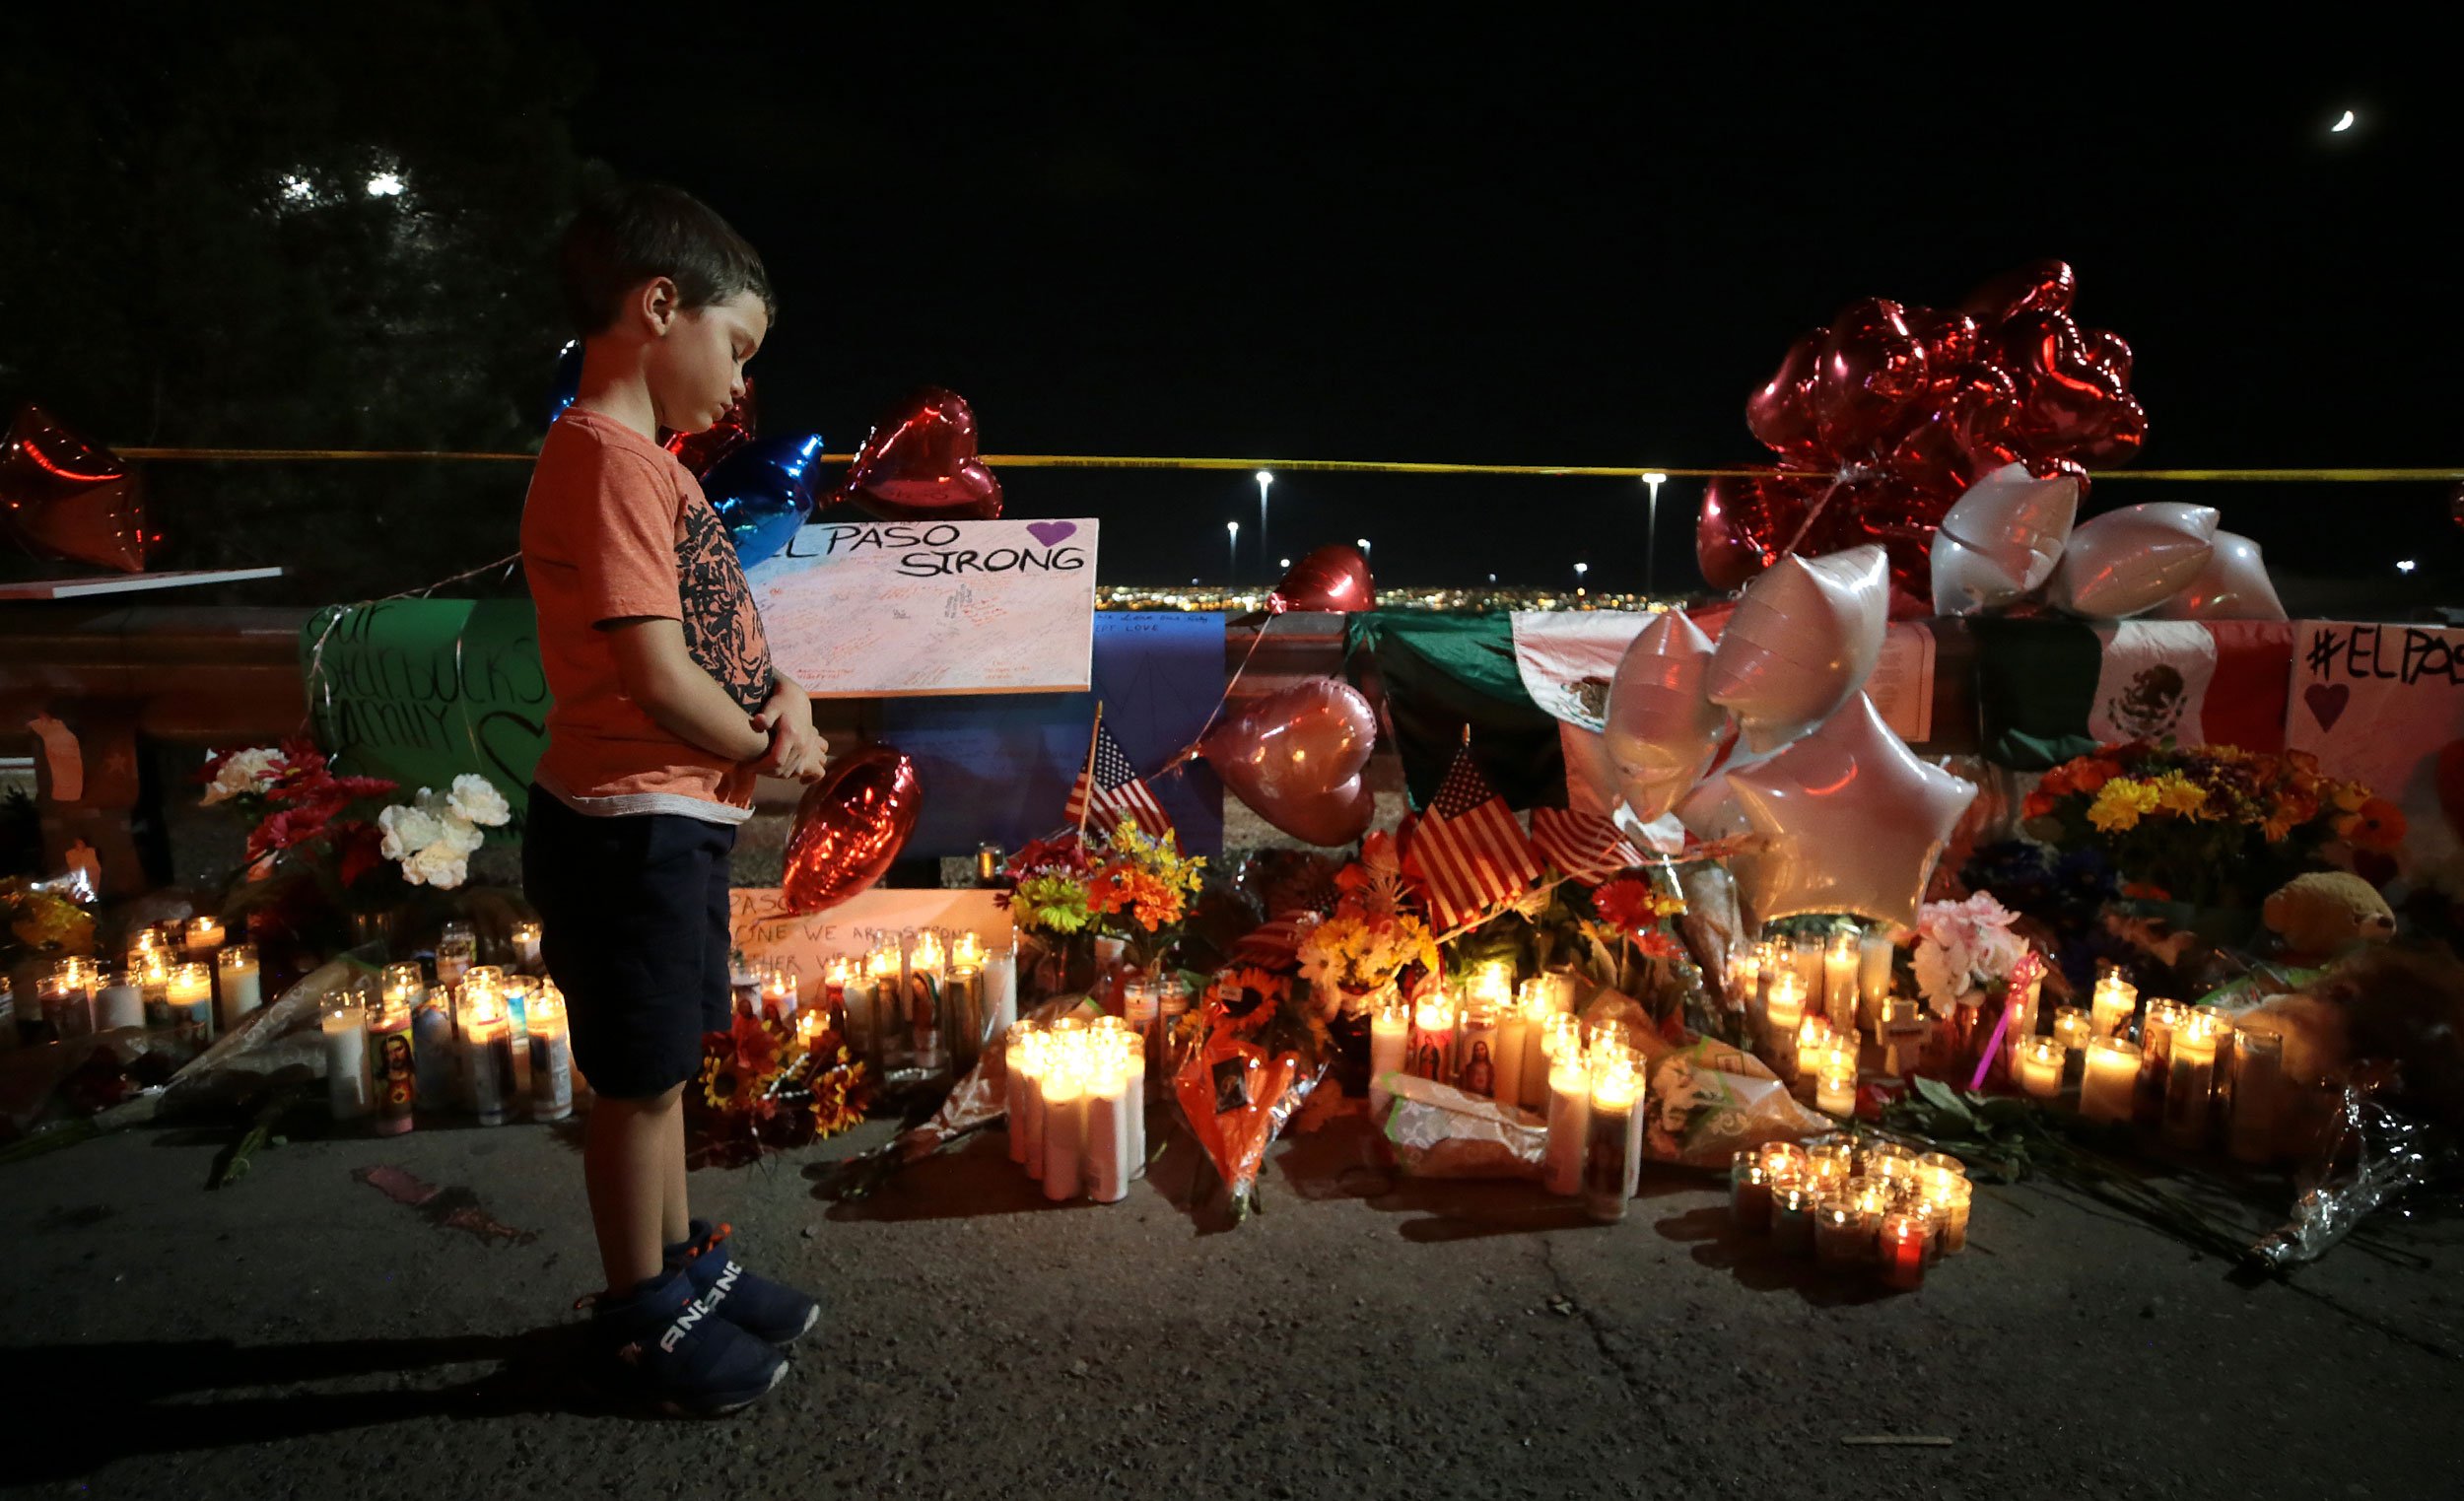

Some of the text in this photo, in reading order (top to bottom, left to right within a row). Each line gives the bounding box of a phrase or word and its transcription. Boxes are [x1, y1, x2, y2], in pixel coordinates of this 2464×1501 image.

[821, 524, 960, 555] PASO
[896, 547, 1085, 577] STRONG
[803, 924, 837, 941] WE
